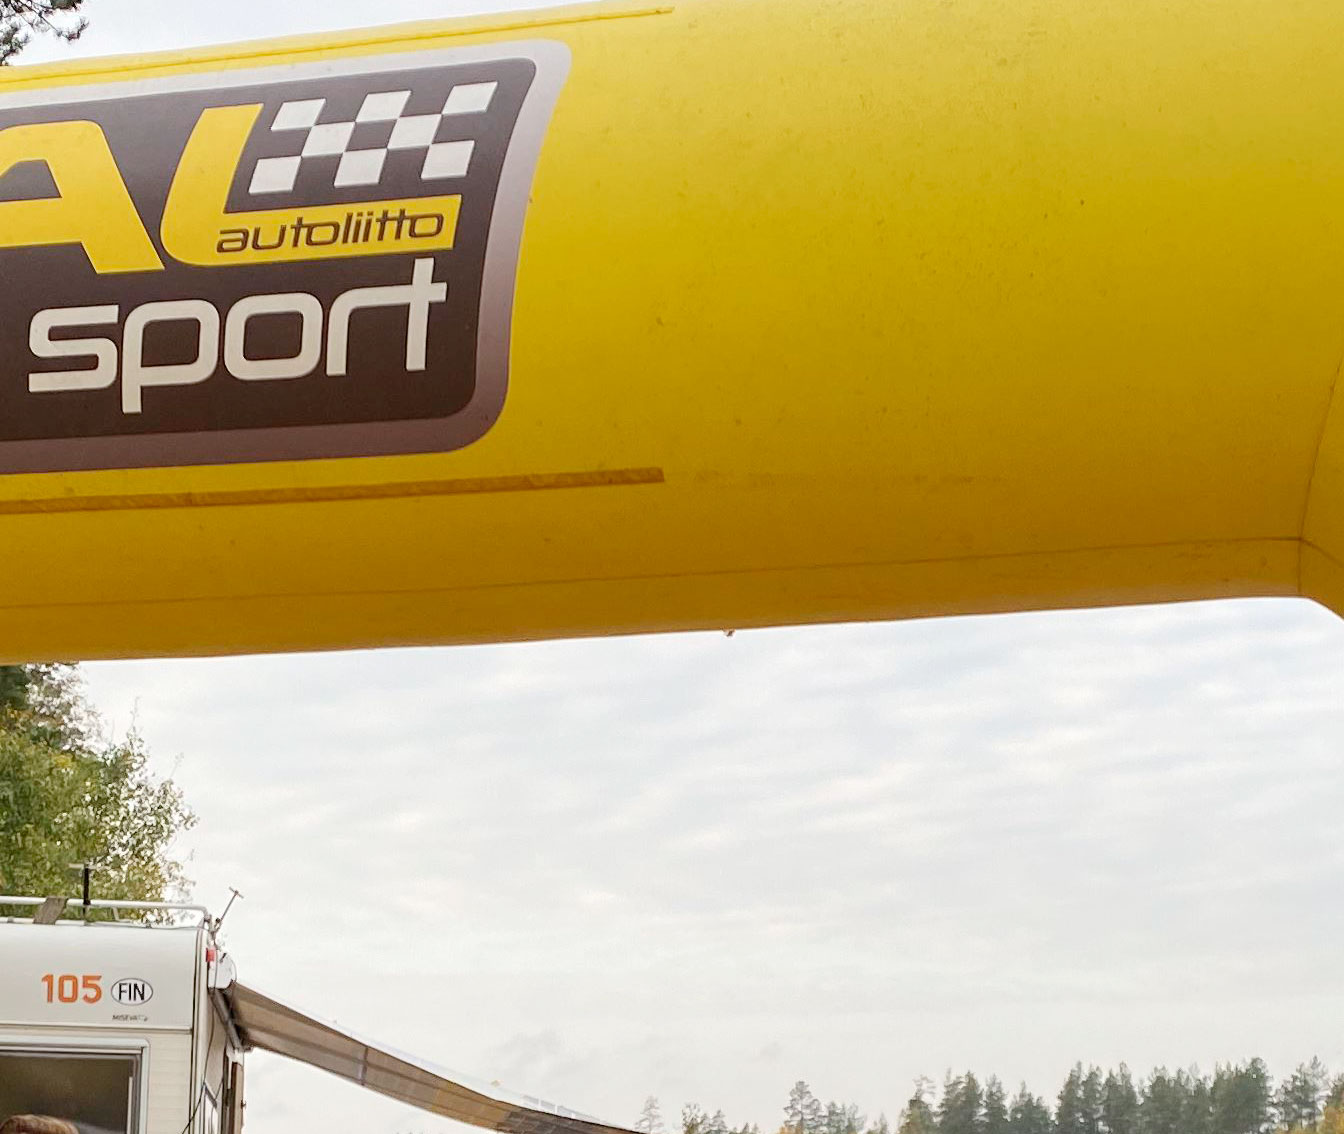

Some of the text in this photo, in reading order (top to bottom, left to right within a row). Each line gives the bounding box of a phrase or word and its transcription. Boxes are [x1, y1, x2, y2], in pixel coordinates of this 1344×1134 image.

[217, 211, 444, 253] autoliitto
[28, 257, 448, 414] sport
[41, 974, 102, 1004] 105
[118, 982, 146, 1002] FIN
